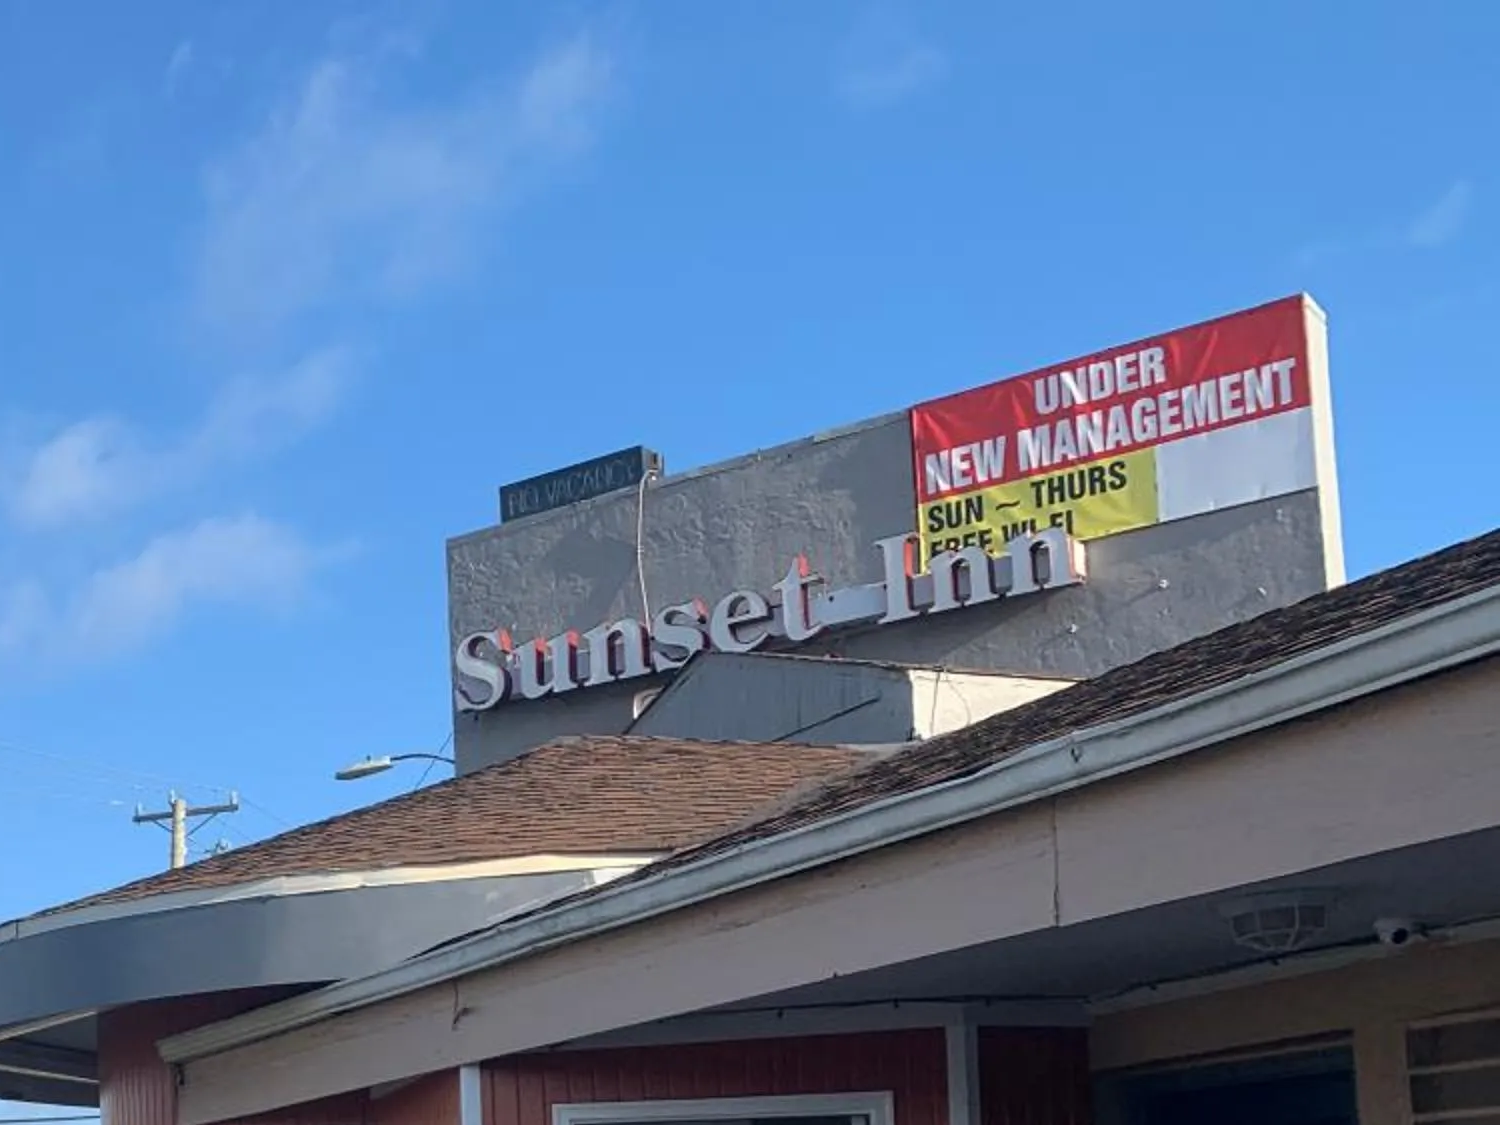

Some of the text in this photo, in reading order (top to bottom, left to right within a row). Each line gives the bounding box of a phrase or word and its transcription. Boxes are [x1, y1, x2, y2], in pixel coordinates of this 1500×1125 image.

[925, 356, 1298, 496] NEW MANAGEMENT
[1032, 346, 1168, 415] UNDER
[928, 496, 985, 533] SUN
[1030, 461, 1127, 509] THURS
[454, 528, 1087, 712] Sunset Inn
